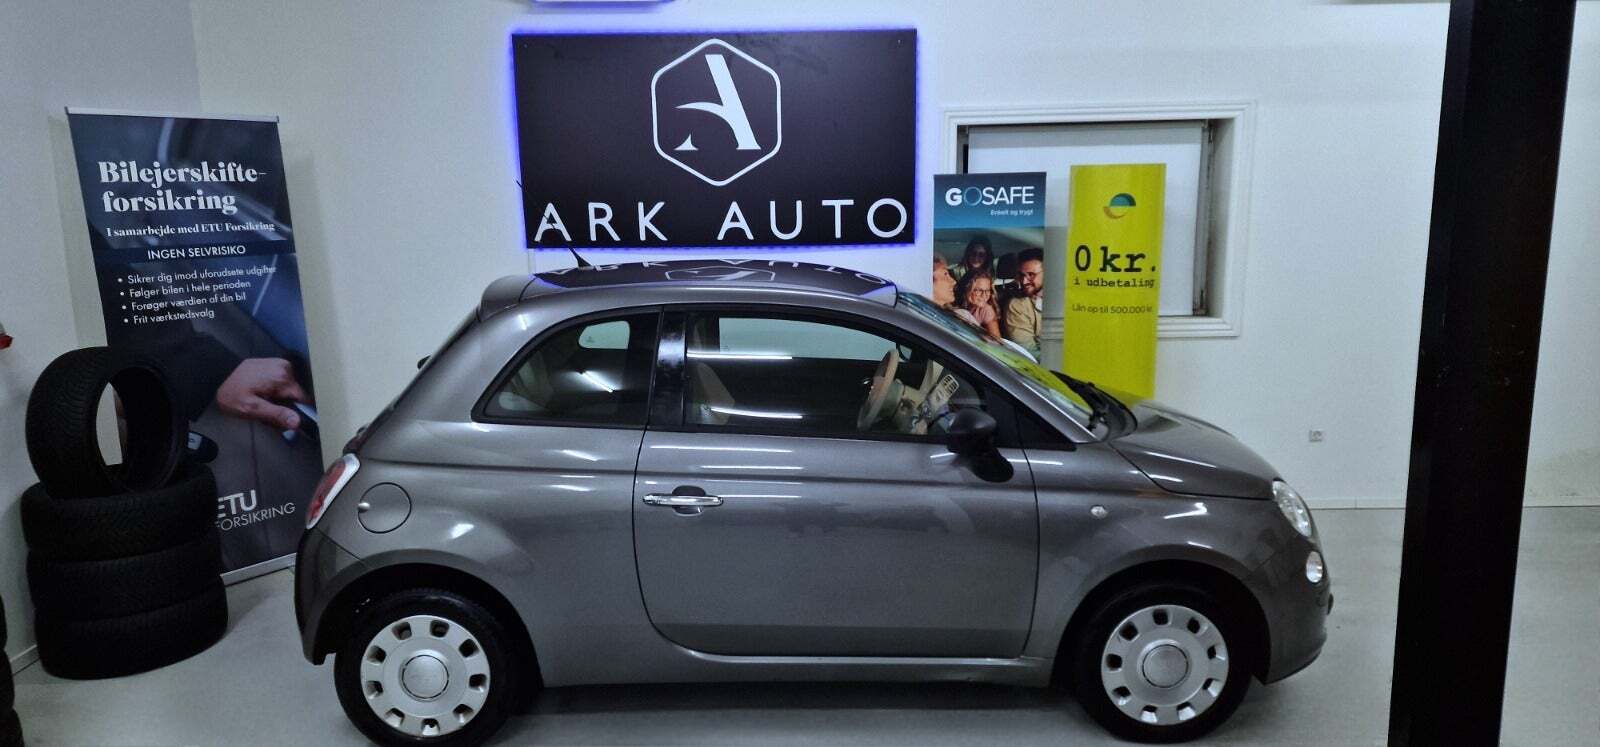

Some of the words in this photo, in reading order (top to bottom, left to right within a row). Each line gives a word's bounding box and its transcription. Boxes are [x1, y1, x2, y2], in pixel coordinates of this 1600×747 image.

[98, 160, 267, 189] Bilejerskifte-
[102, 189, 238, 215] forsikring
[945, 186, 1035, 206] GOSAFE
[107, 227, 112, 237] I
[113, 224, 176, 237] samarbejde
[178, 225, 200, 235] med
[201, 223, 224, 233] ETU
[225, 221, 275, 232] Forsikring
[534, 201, 669, 242] ARK
[716, 198, 908, 241] AUTO
[147, 249, 186, 260] INGEN
[188, 245, 246, 258] SELVRISIKO
[1075, 244, 1091, 272] 0
[1099, 246, 1156, 273] kr.
[127, 274, 155, 284] Sikrer
[157, 271, 173, 283] dig
[174, 270, 198, 281] imod
[199, 267, 245, 280] uforudsete
[246, 264, 277, 277] udgifter
[1087, 278, 1155, 288] udbetaling
[129, 287, 160, 299] Følger
[161, 284, 184, 295] bilen
[191, 282, 211, 292] hele
[212, 279, 251, 292] perioden
[131, 299, 169, 313] Forøger
[170, 297, 207, 307] værdien
[209, 295, 218, 305] af
[219, 293, 234, 303] din
[235, 290, 247, 302] bil
[1087, 305, 1099, 314] op
[1110, 305, 1146, 314] 500.000
[133, 314, 149, 325] Frit
[150, 309, 215, 322] værkstedsvalg
[217, 489, 258, 518] ETU
